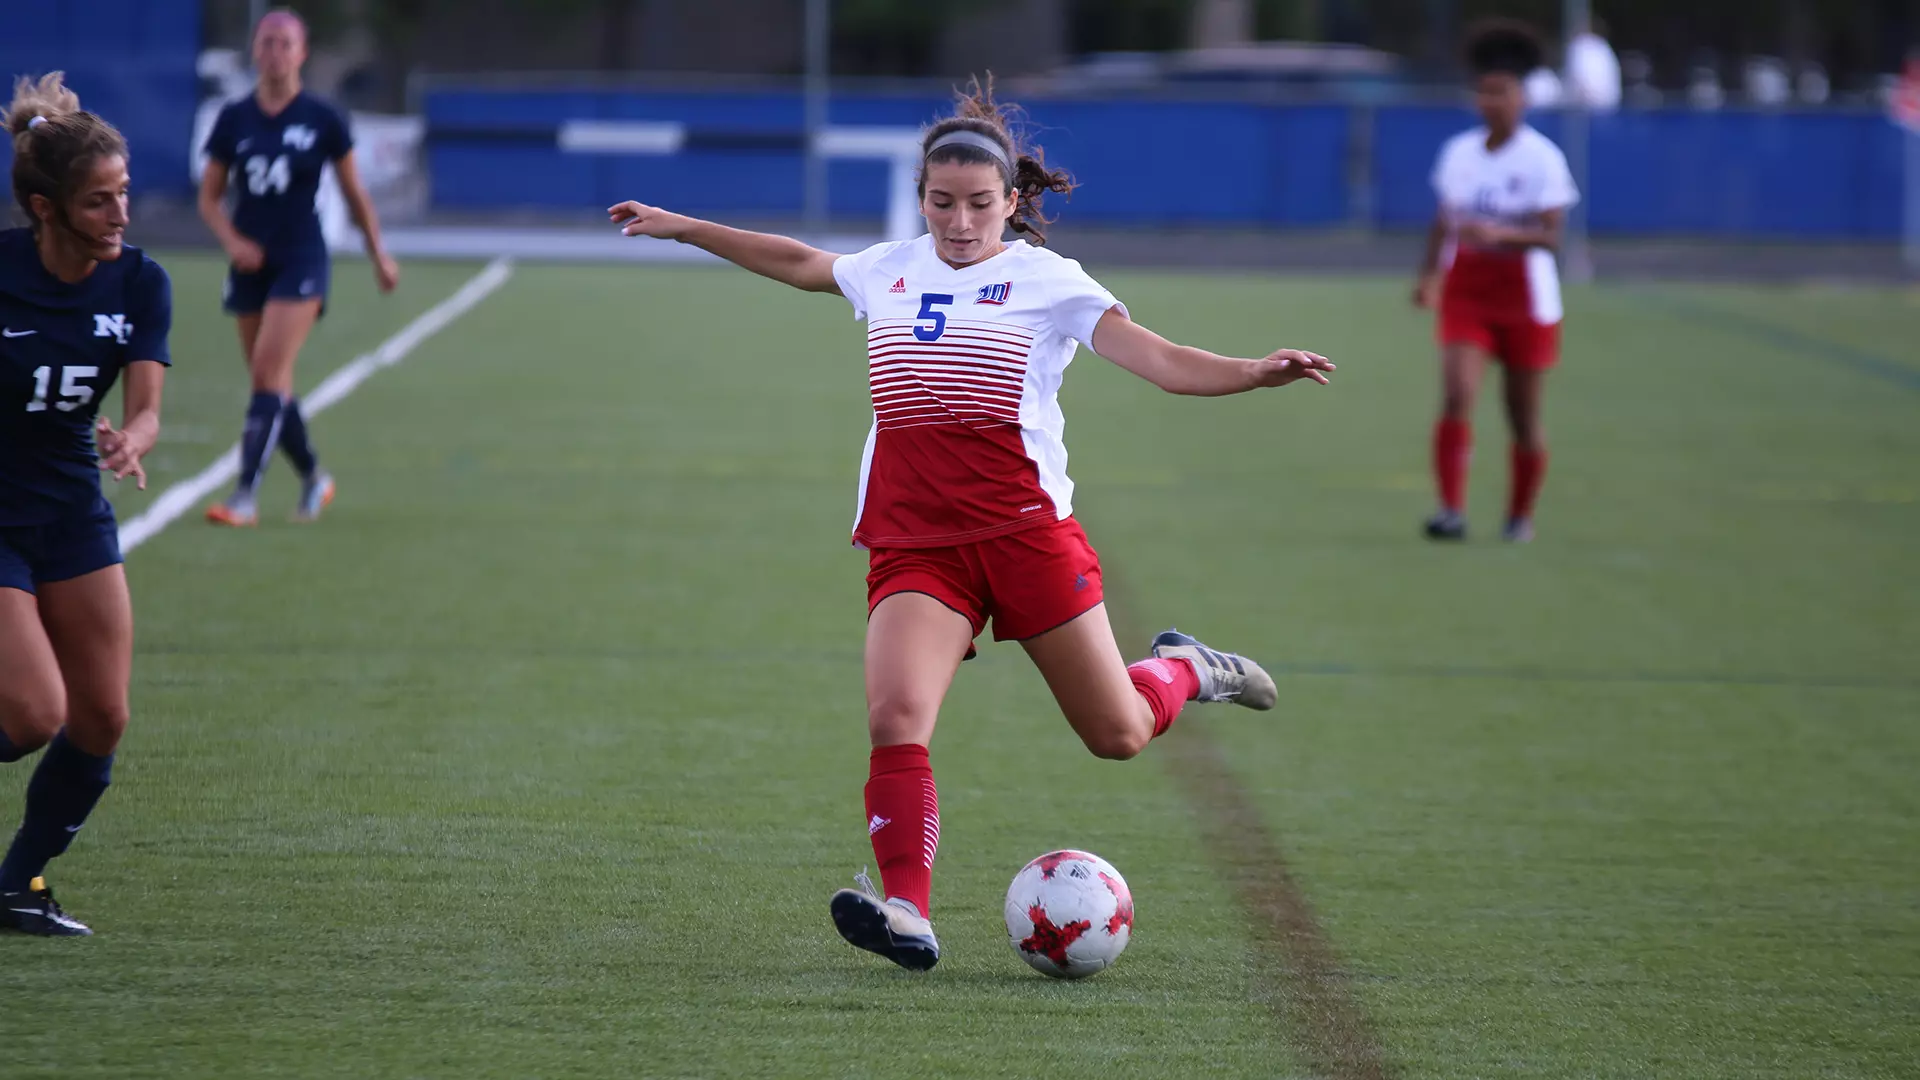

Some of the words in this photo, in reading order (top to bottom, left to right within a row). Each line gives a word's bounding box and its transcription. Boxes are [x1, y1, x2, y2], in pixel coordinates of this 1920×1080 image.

[245, 153, 291, 196] 24
[912, 293, 954, 342] 5
[25, 365, 100, 413] 15
